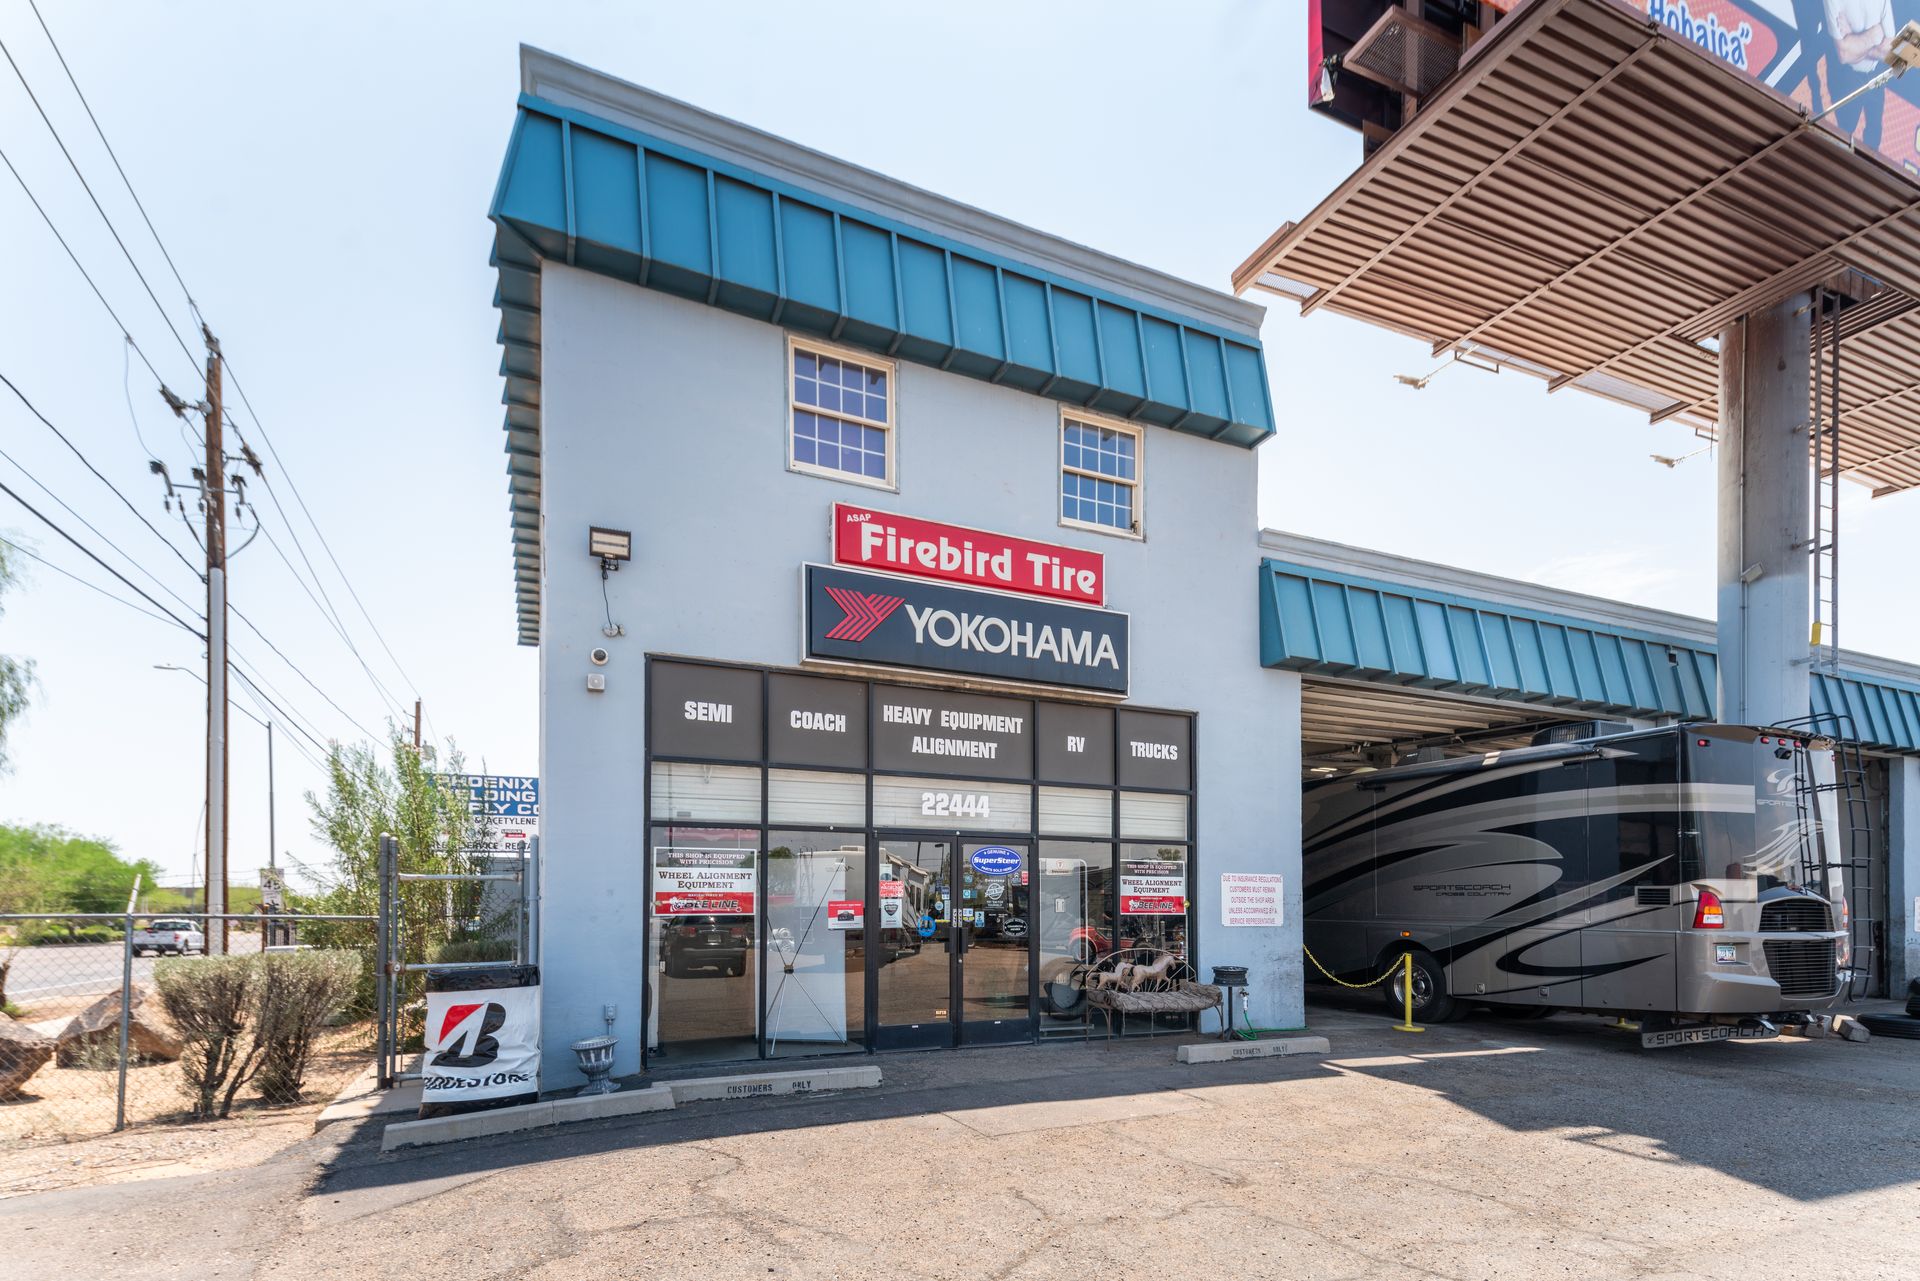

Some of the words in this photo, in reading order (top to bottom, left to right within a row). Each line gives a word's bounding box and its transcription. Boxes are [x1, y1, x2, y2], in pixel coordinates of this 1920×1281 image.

[846, 513, 862, 522] ASAP
[861, 521, 1012, 582] Firebird
[1026, 552, 1096, 595] Tire
[904, 603, 1119, 670] YOKOHAMA
[684, 700, 733, 724] SEMI
[883, 704, 932, 726] HEAVY
[940, 709, 1024, 734] EQUIPMENT
[790, 710, 846, 733] COACH
[912, 736, 998, 759] ALIGNMENT
[1067, 735, 1085, 753] RV
[1130, 741, 1178, 761] TRUCKS
[921, 792, 990, 818] 22444
[486, 816, 537, 825] ACETYLENE
[973, 856, 1020, 865] SuperSteer
[658, 871, 694, 880] WHEEL
[697, 871, 753, 880] ALIGNMENT
[1145, 879, 1182, 887] ALIGNMENT
[677, 880, 734, 890] EQUIPMENT
[1133, 886, 1170, 894] EQUIPMENT
[1413, 883, 1512, 891] SPORTSCOACH
[711, 899, 739, 909] LINE
[1656, 1026, 1765, 1045] SPORTSCOACH
[727, 1083, 773, 1094] CUSTOMERS
[792, 1080, 812, 1089] ONLY
